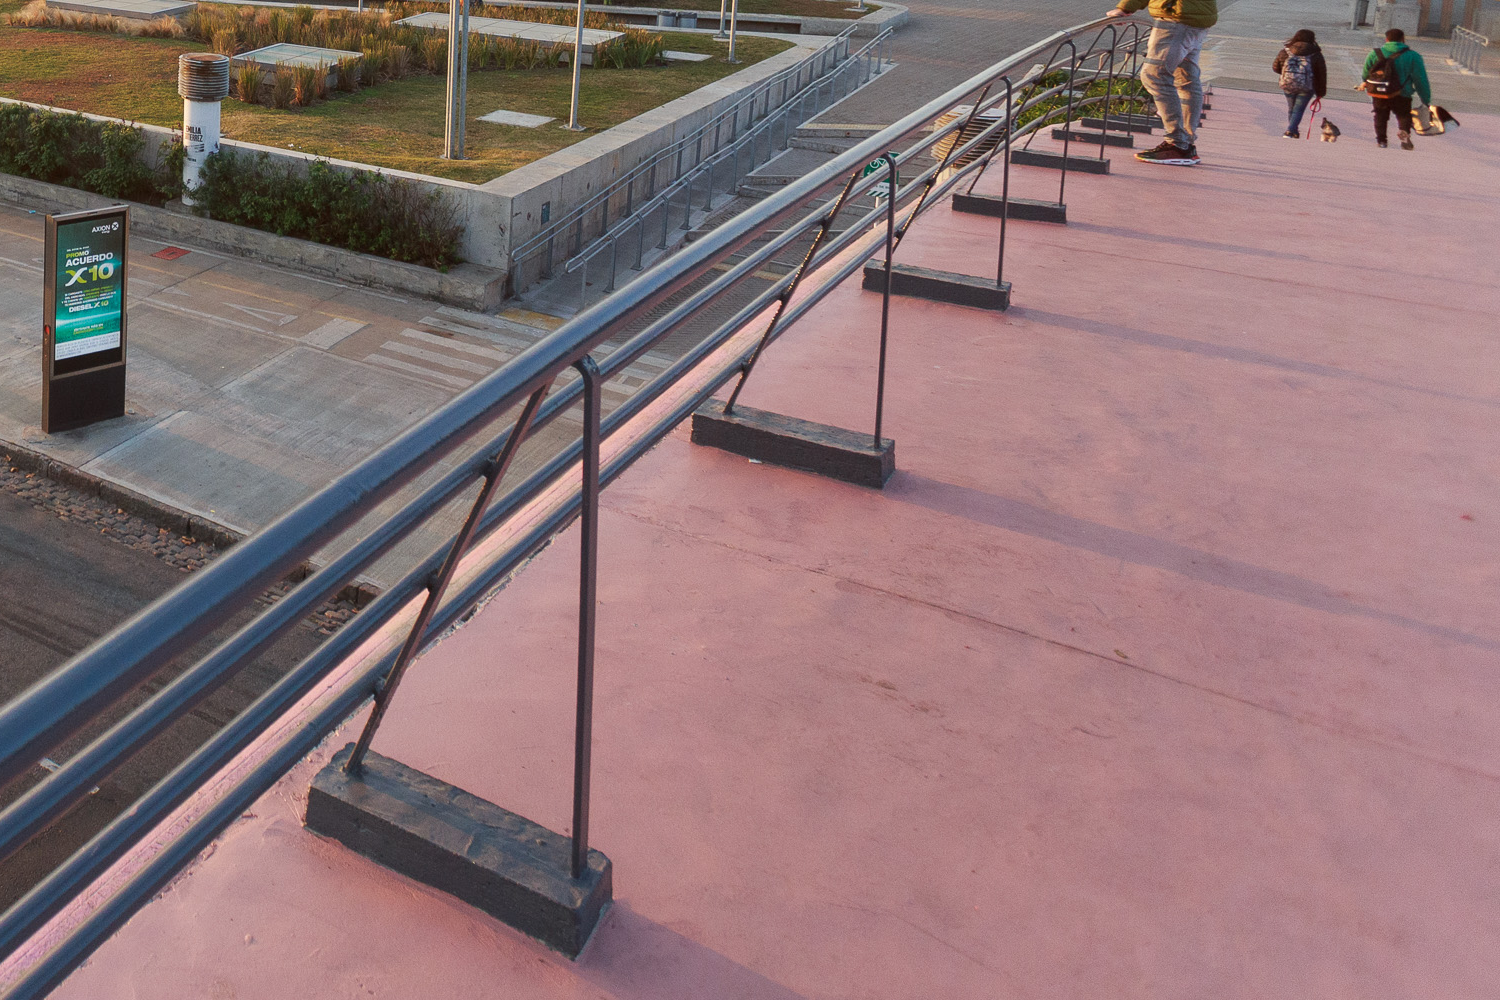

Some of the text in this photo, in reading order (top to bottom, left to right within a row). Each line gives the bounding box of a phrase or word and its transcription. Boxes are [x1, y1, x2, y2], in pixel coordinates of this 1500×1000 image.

[91, 224, 111, 233] AXION
[65, 250, 90, 259] PROMO
[65, 252, 114, 267] ACUERDO
[68, 303, 94, 313] DIESEL
